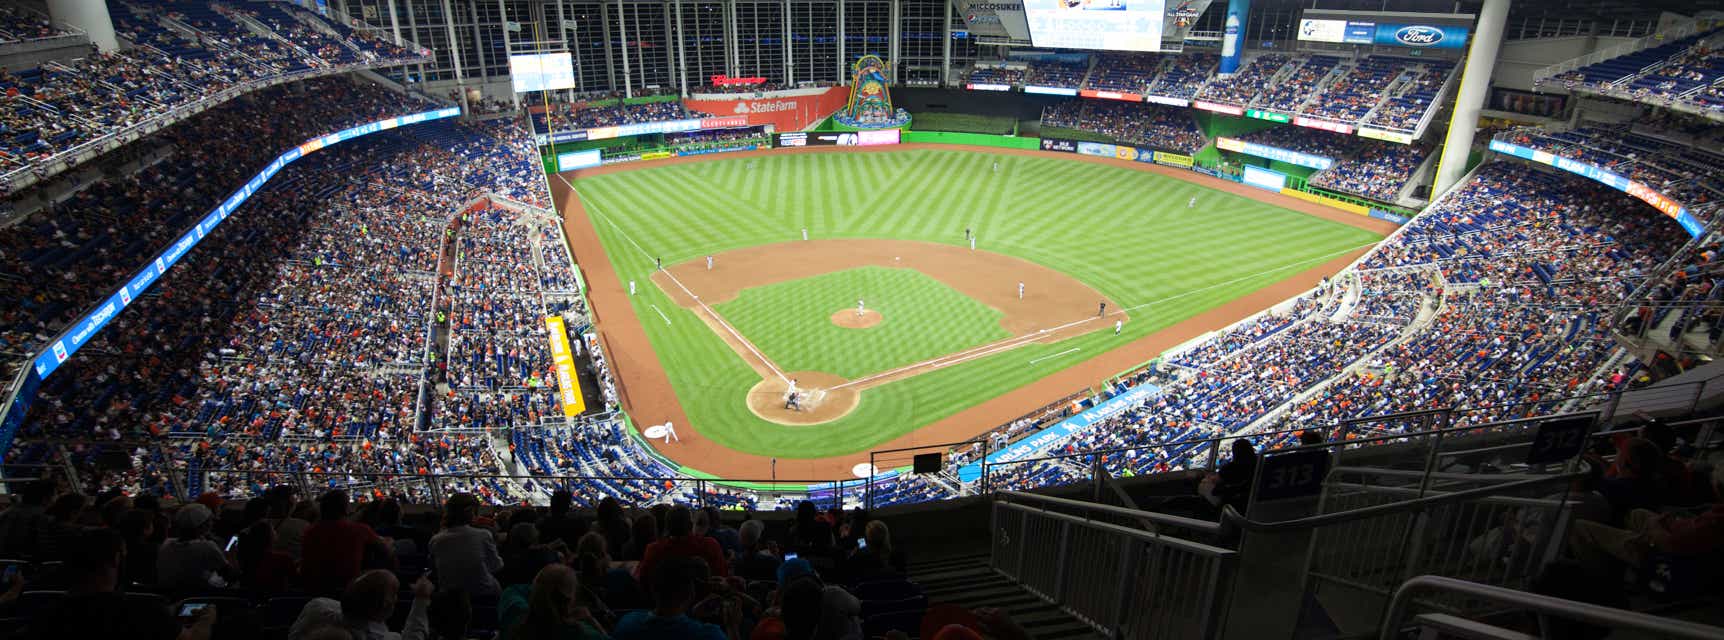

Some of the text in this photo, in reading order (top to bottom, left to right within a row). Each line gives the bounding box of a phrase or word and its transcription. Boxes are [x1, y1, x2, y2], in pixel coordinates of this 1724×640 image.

[969, 3, 1021, 11] MICCOSUKEE
[1403, 28, 1435, 42] Ford
[1541, 428, 1581, 452] 312
[1270, 464, 1314, 488] 313
